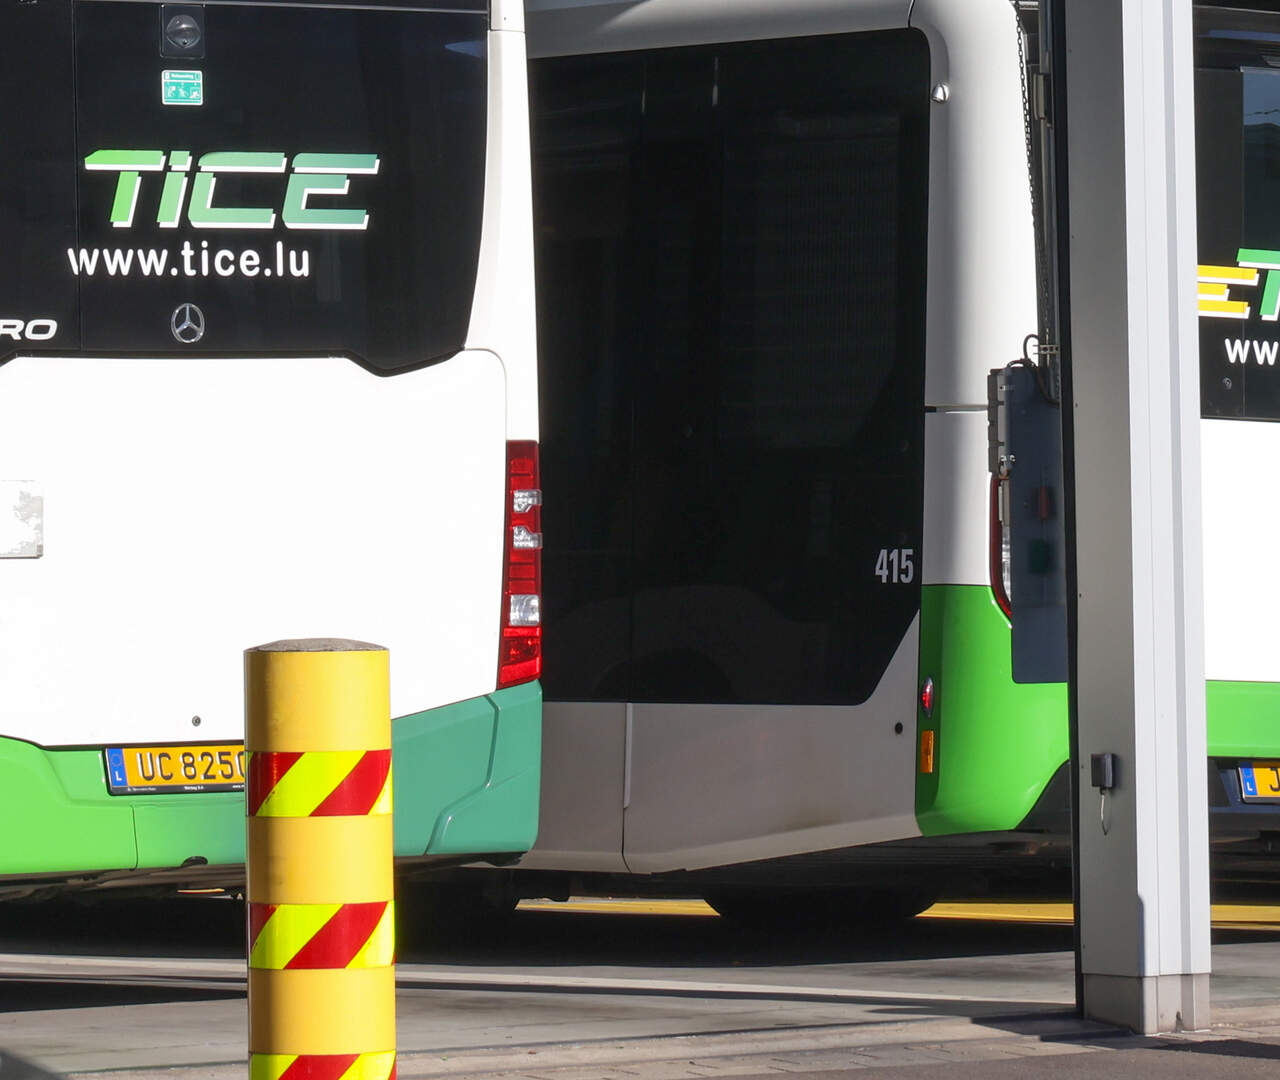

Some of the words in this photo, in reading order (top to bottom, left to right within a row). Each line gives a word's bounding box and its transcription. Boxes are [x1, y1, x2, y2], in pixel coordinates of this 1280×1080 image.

[84, 149, 380, 231] TICE
[66, 240, 310, 278] www.tice.lu
[874, 548, 914, 584] 415
[115, 770, 123, 782] L
[138, 751, 174, 781] UC
